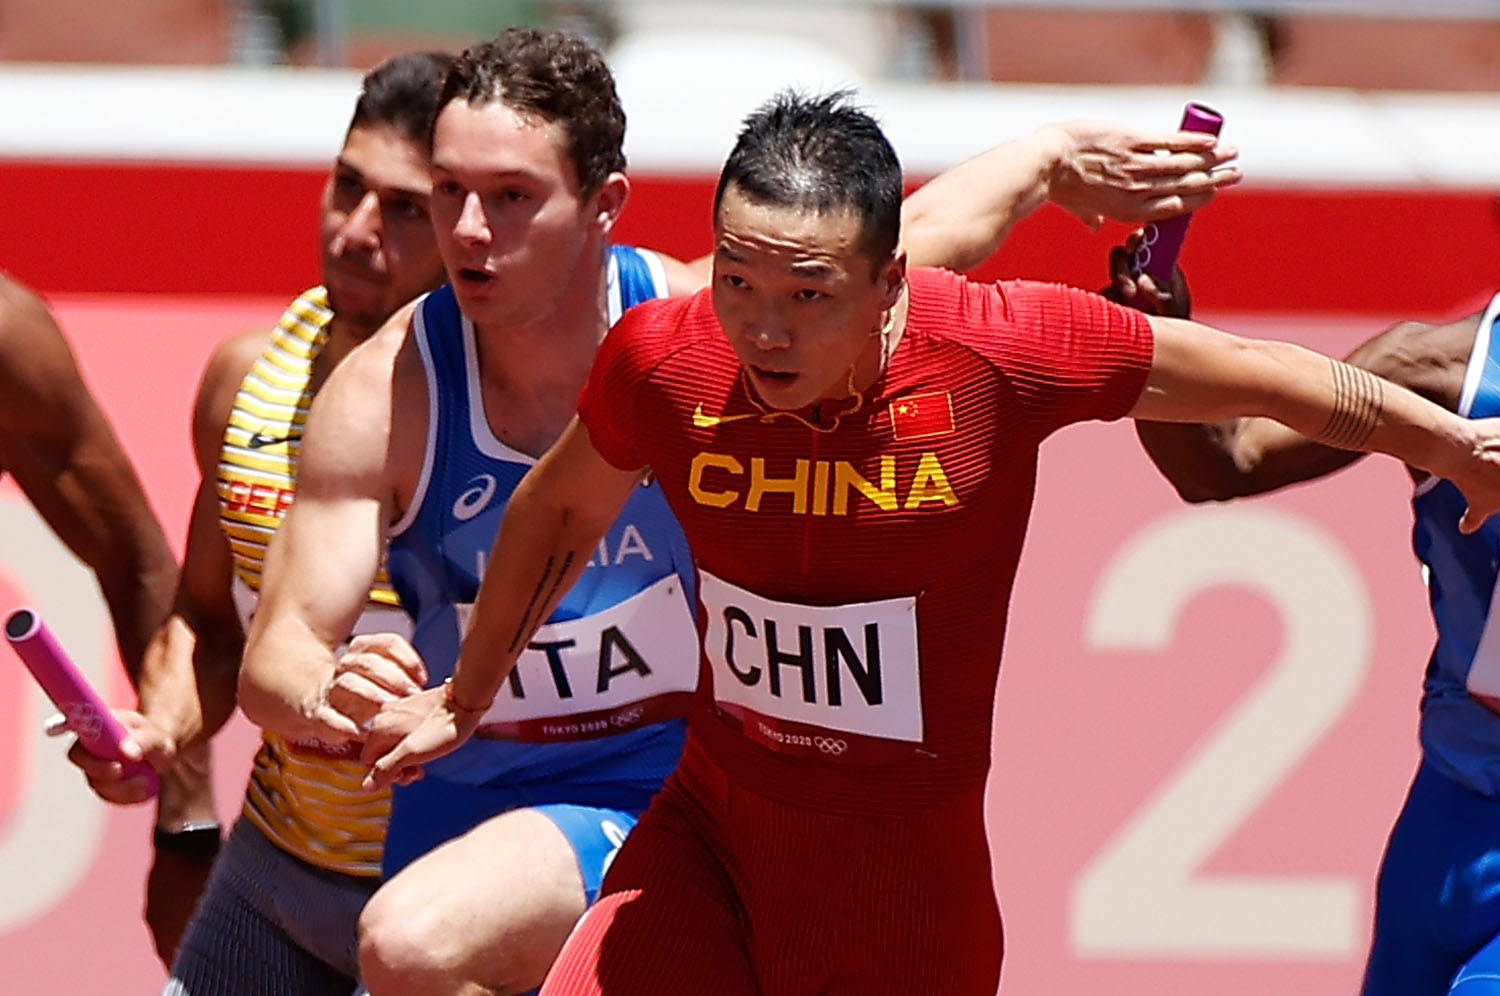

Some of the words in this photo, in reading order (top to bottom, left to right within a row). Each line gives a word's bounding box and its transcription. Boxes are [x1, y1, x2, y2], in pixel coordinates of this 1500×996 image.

[687, 451, 960, 517] CHINA
[723, 605, 884, 707] CHN
[785, 733, 812, 747] 2020
